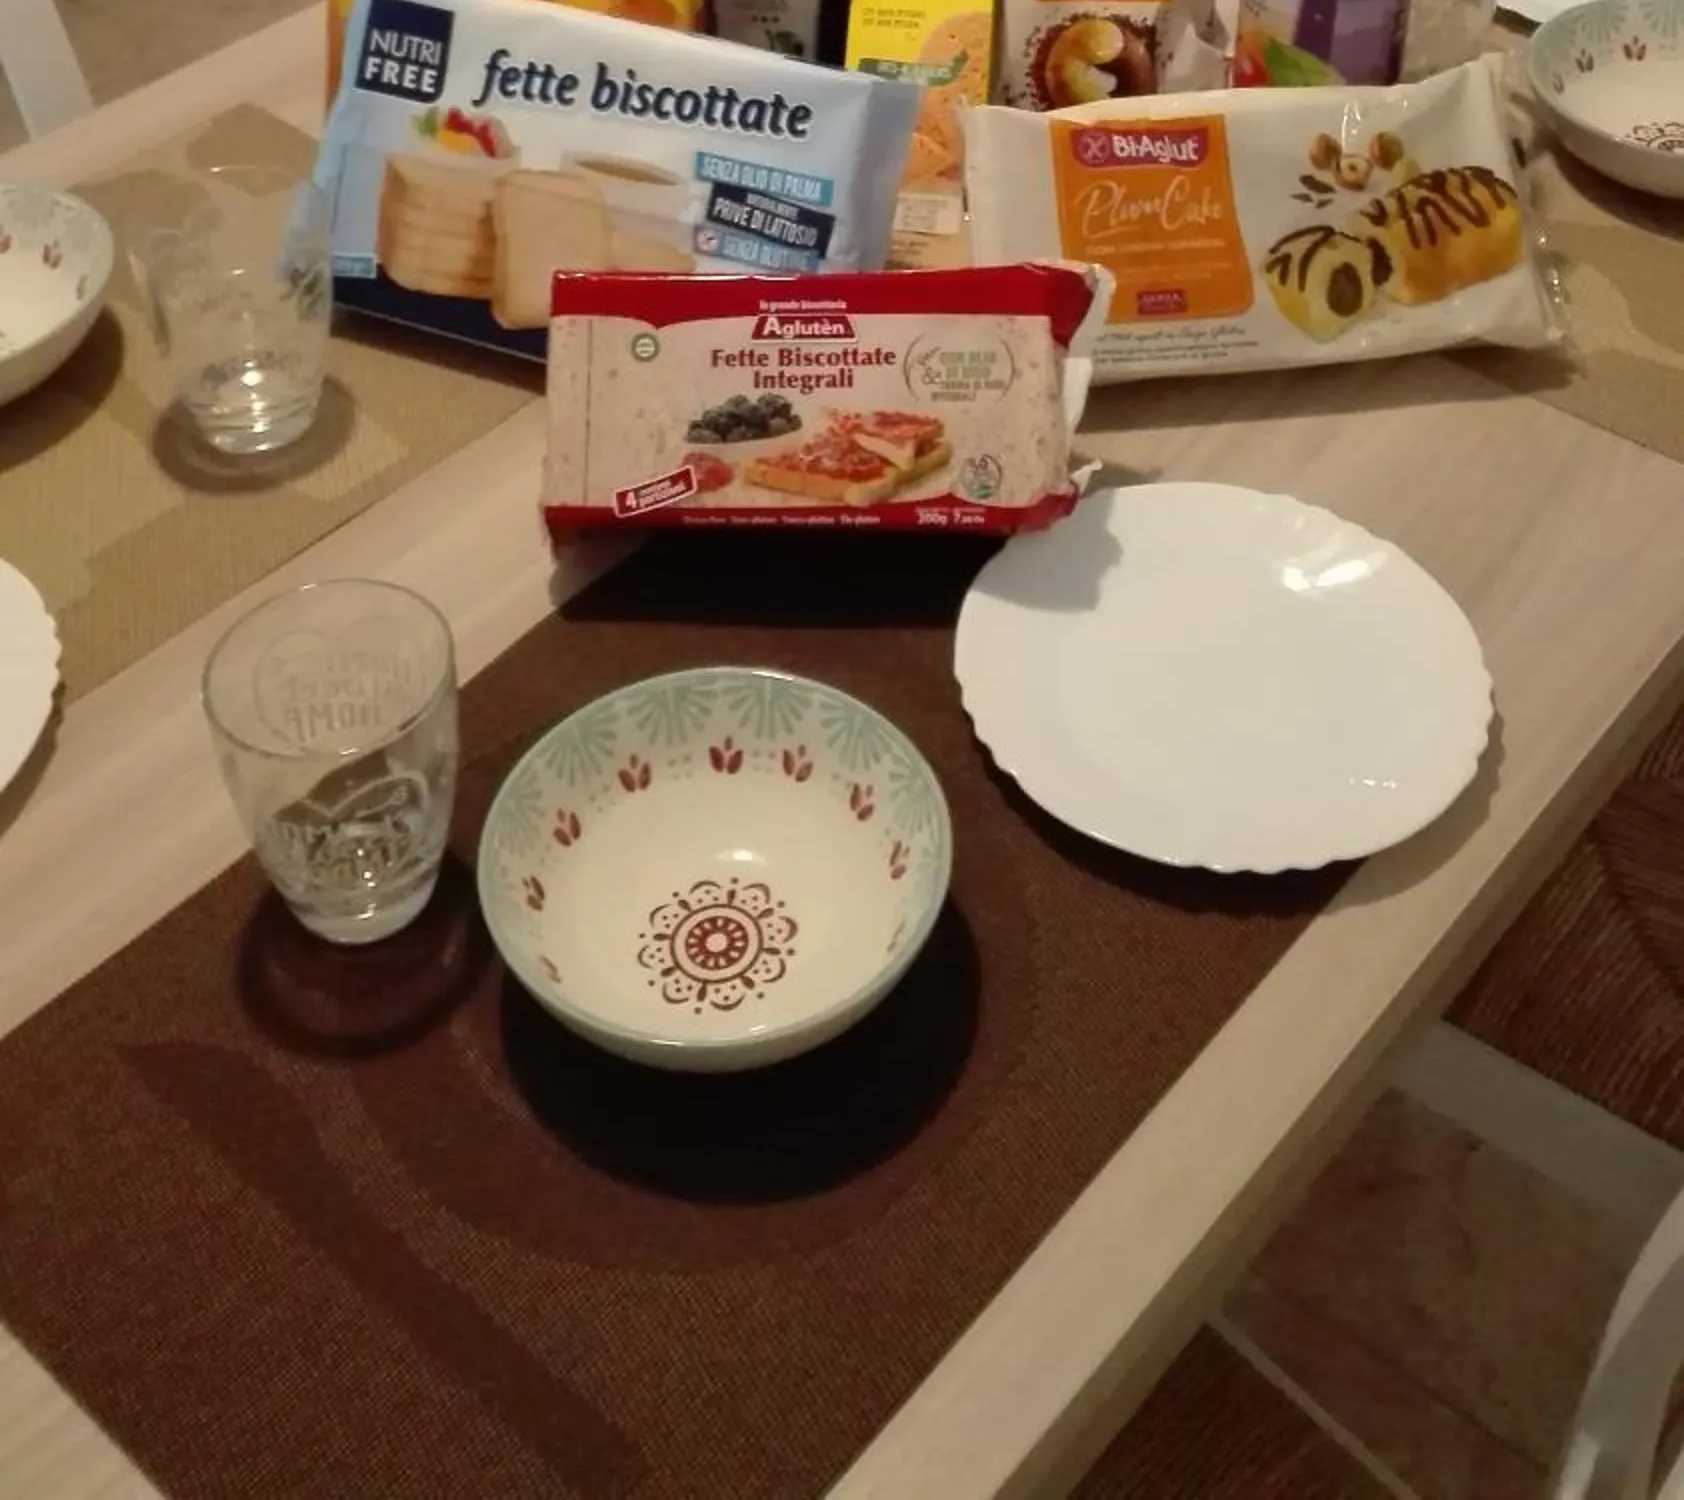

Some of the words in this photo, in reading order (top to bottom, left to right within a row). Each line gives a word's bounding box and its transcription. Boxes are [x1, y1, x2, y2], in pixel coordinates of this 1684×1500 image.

[370, 28, 443, 66] NUTRI
[364, 56, 439, 94] FREE
[471, 48, 579, 108] fette
[590, 61, 813, 138] biscottate
[763, 316, 845, 340] Aglutèn
[711, 349, 769, 368] Fette
[777, 347, 897, 367] Biscottate
[753, 368, 854, 395] Integrali
